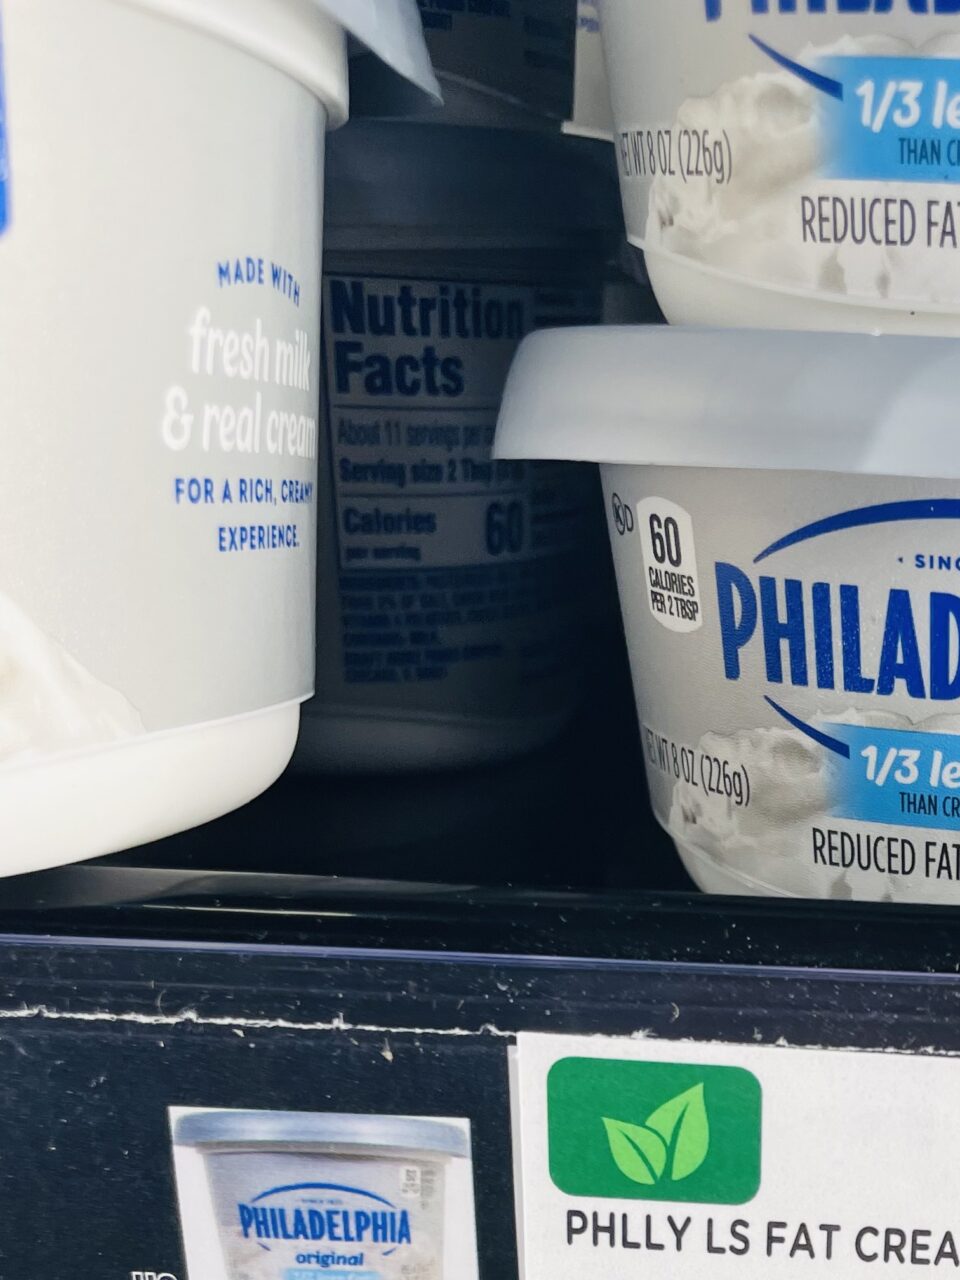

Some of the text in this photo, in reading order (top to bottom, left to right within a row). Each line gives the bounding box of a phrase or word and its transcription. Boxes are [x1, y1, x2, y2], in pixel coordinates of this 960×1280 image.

[855, 80, 923, 134] 1/3
[647, 130, 656, 175] 8
[657, 129, 676, 176] OZ
[678, 128, 733, 185] (226g)
[898, 137, 941, 166] THAN
[801, 196, 916, 247] REDUCED
[217, 256, 300, 307] MADE WITH
[330, 280, 526, 341] Nutrition
[190, 305, 312, 392] fresh milk
[333, 341, 464, 397] Facts
[161, 385, 317, 459] & real cream
[174, 477, 215, 504] FOR
[222, 479, 233, 503] A
[239, 478, 278, 506] RICH,
[217, 524, 300, 552] EXPERIENCE.
[343, 500, 527, 557] Calories 60
[649, 513, 682, 567] 60
[649, 566, 695, 598] CALORIES
[650, 590, 699, 621] PER 2 TBSP
[671, 742, 680, 779] 8
[681, 747, 698, 786] OZ
[700, 754, 751, 807] (226g)
[861, 745, 919, 787] 1/3
[899, 792, 938, 817] THAN
[811, 827, 916, 877] REDUCED
[238, 1203, 412, 1244] PHILADELPHIA
[566, 1209, 692, 1252] PHLLY
[706, 1217, 751, 1256] LS
[766, 1222, 842, 1260] FAT
[295, 1251, 365, 1268] original
